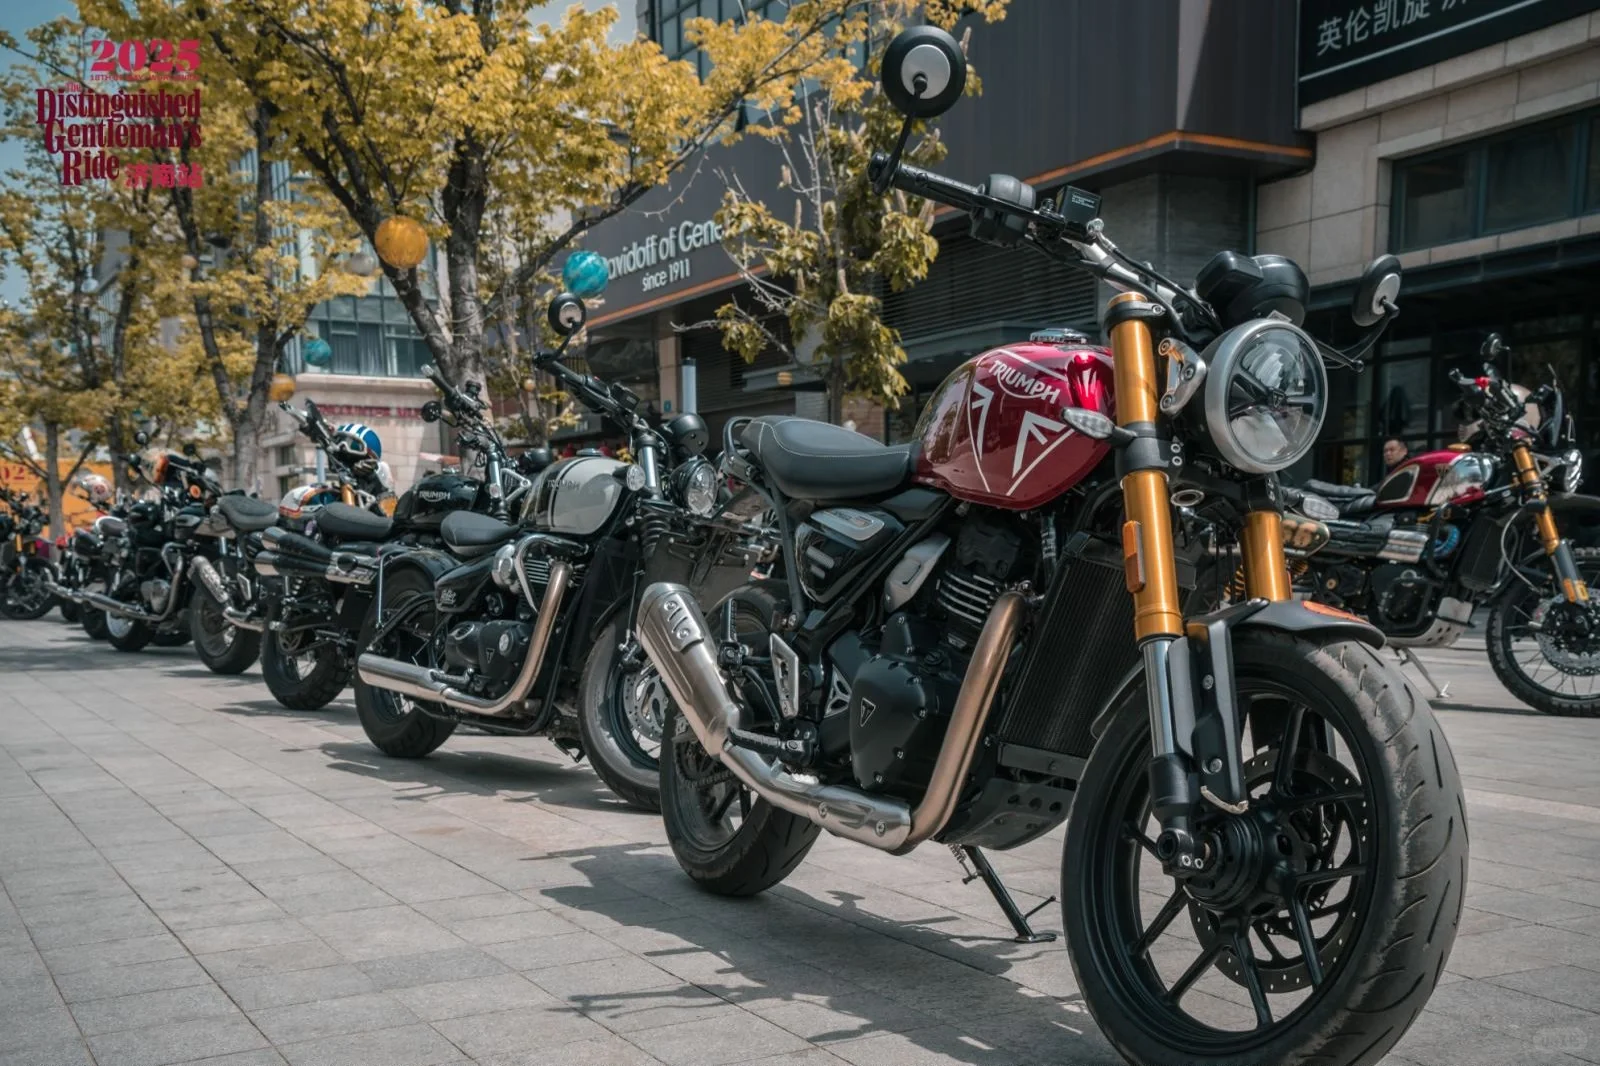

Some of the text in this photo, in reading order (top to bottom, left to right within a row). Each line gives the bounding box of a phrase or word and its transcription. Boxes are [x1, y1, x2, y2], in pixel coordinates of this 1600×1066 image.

[1317, 0, 1431, 57] 英伦凯旋
[603, 234, 658, 280] avidoff
[659, 226, 677, 260] of
[642, 258, 690, 292] since 1911
[988, 359, 1061, 404] TRIUMPH
[419, 490, 451, 502] TRIUMPH
